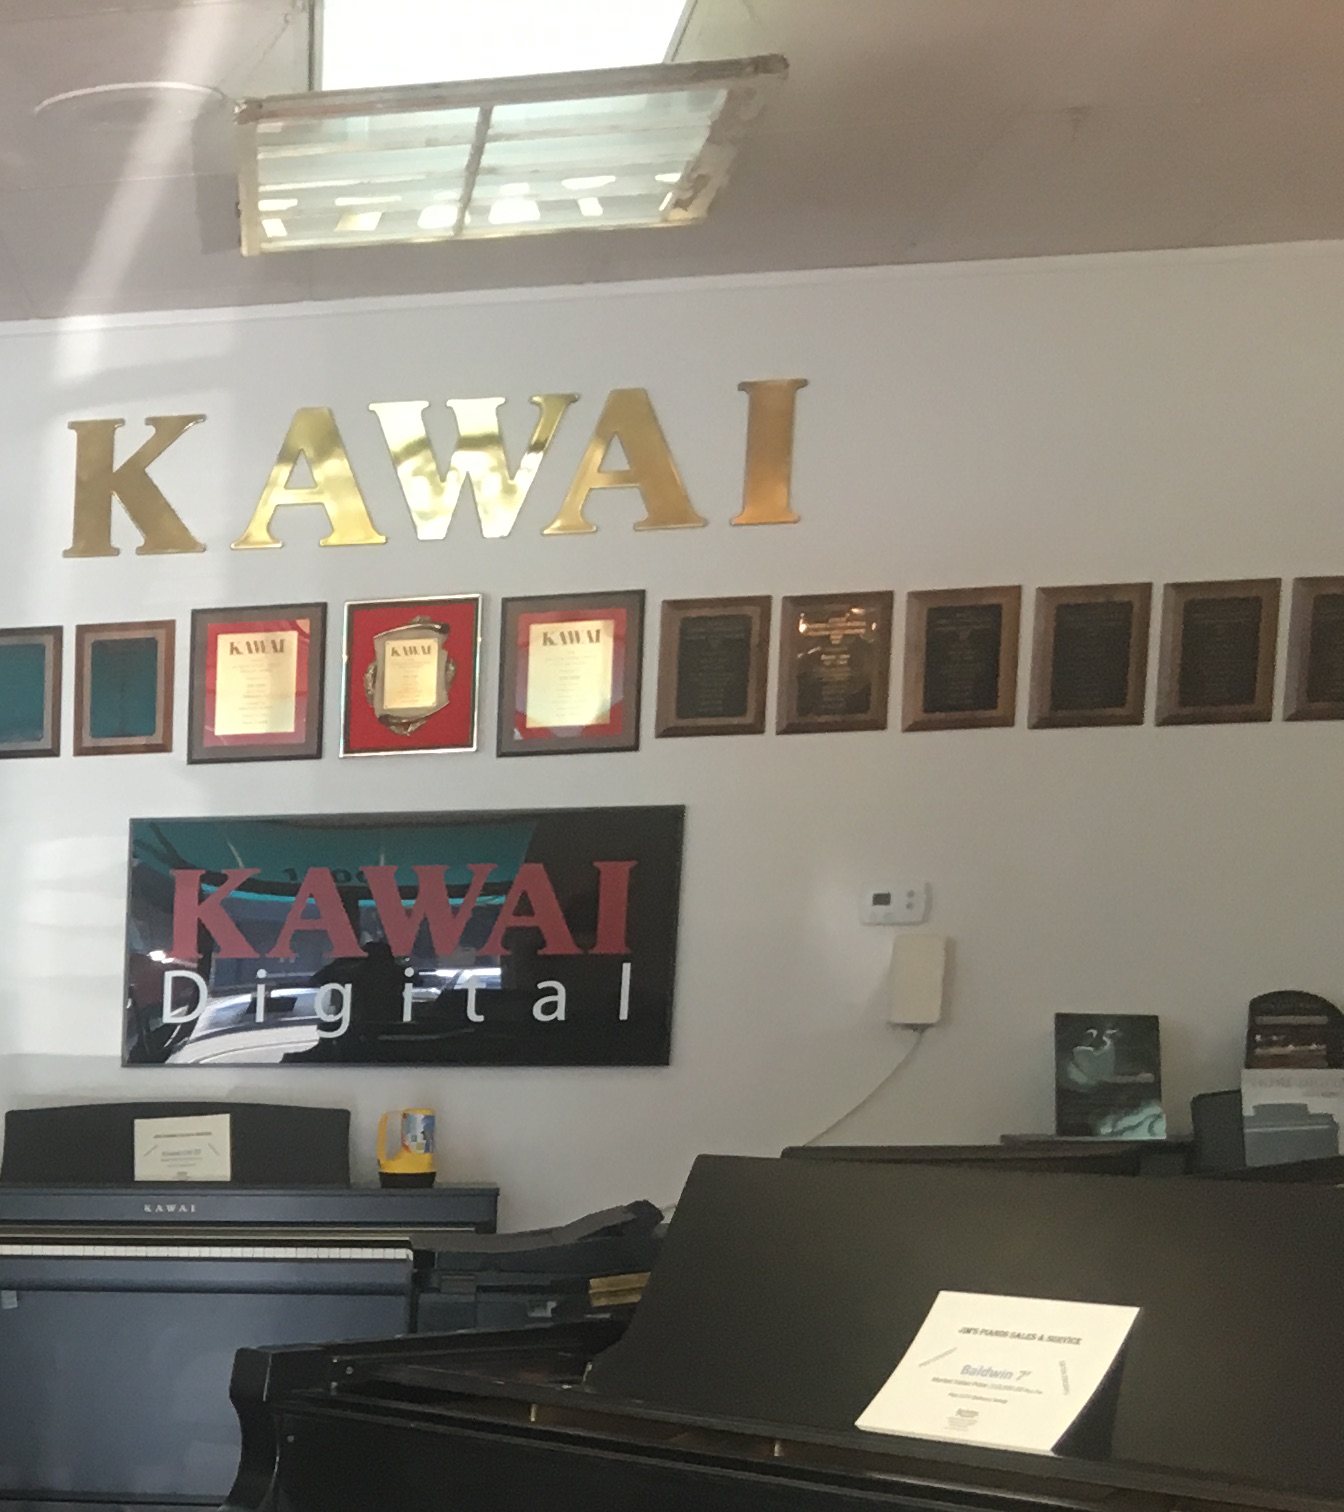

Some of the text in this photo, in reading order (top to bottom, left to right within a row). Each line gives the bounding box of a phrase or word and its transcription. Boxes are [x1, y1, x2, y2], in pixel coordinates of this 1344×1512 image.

[62, 377, 808, 558] KAWAI
[541, 627, 603, 647] KAWAI
[228, 639, 287, 656] KAWAI
[390, 645, 433, 658] KAWAI
[169, 860, 639, 959] KAWAI
[160, 961, 633, 1039] Digital
[143, 1203, 196, 1213] KAWAI
[960, 1364, 1013, 1380] Baldwin
